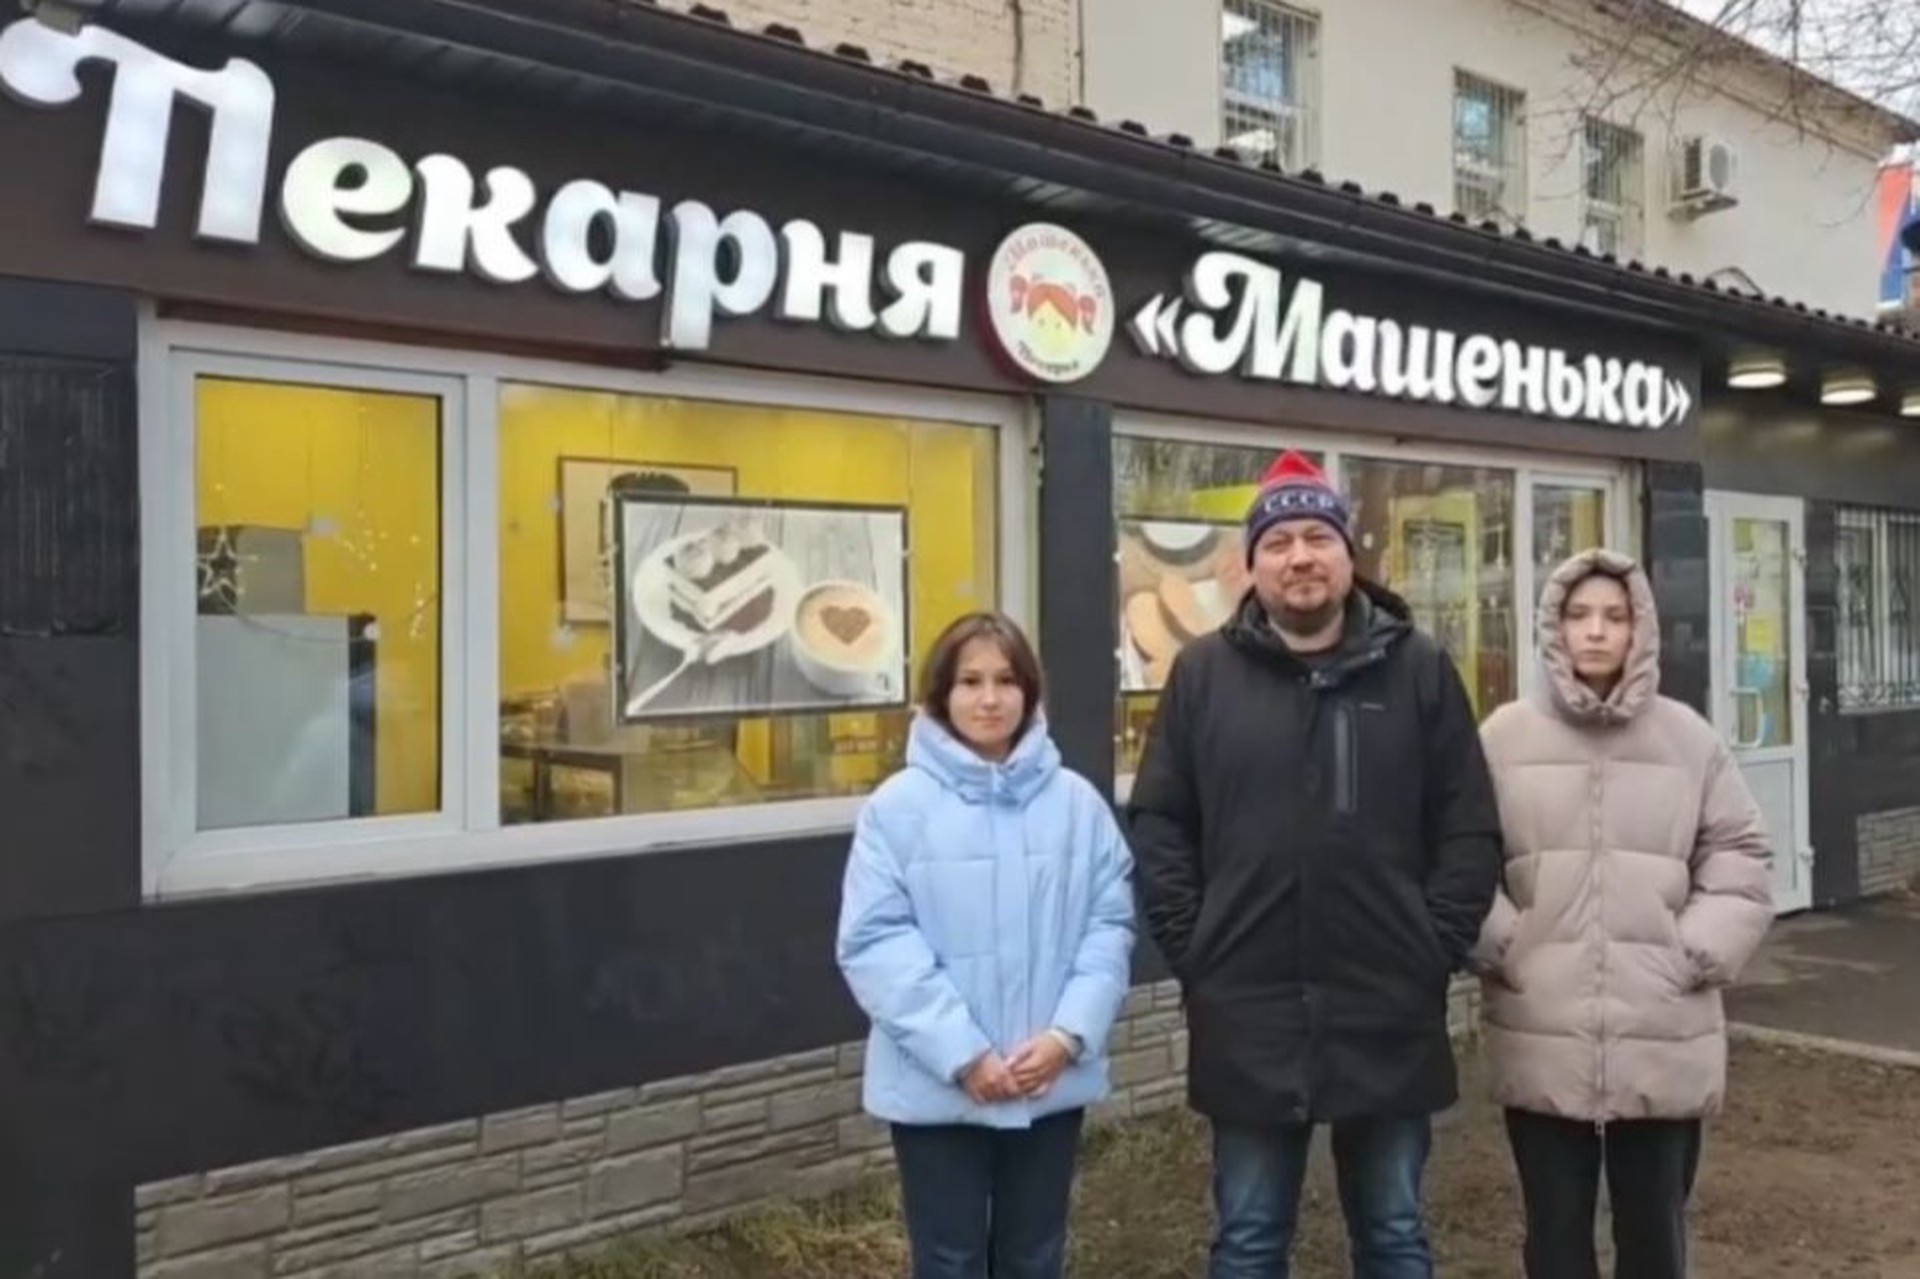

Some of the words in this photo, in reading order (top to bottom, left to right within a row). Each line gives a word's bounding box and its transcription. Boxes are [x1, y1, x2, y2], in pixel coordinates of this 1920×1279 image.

[0, 18, 965, 350] Пекарня
[1133, 252, 1691, 428] «Машенька»
[1264, 491, 1335, 514] СССР
